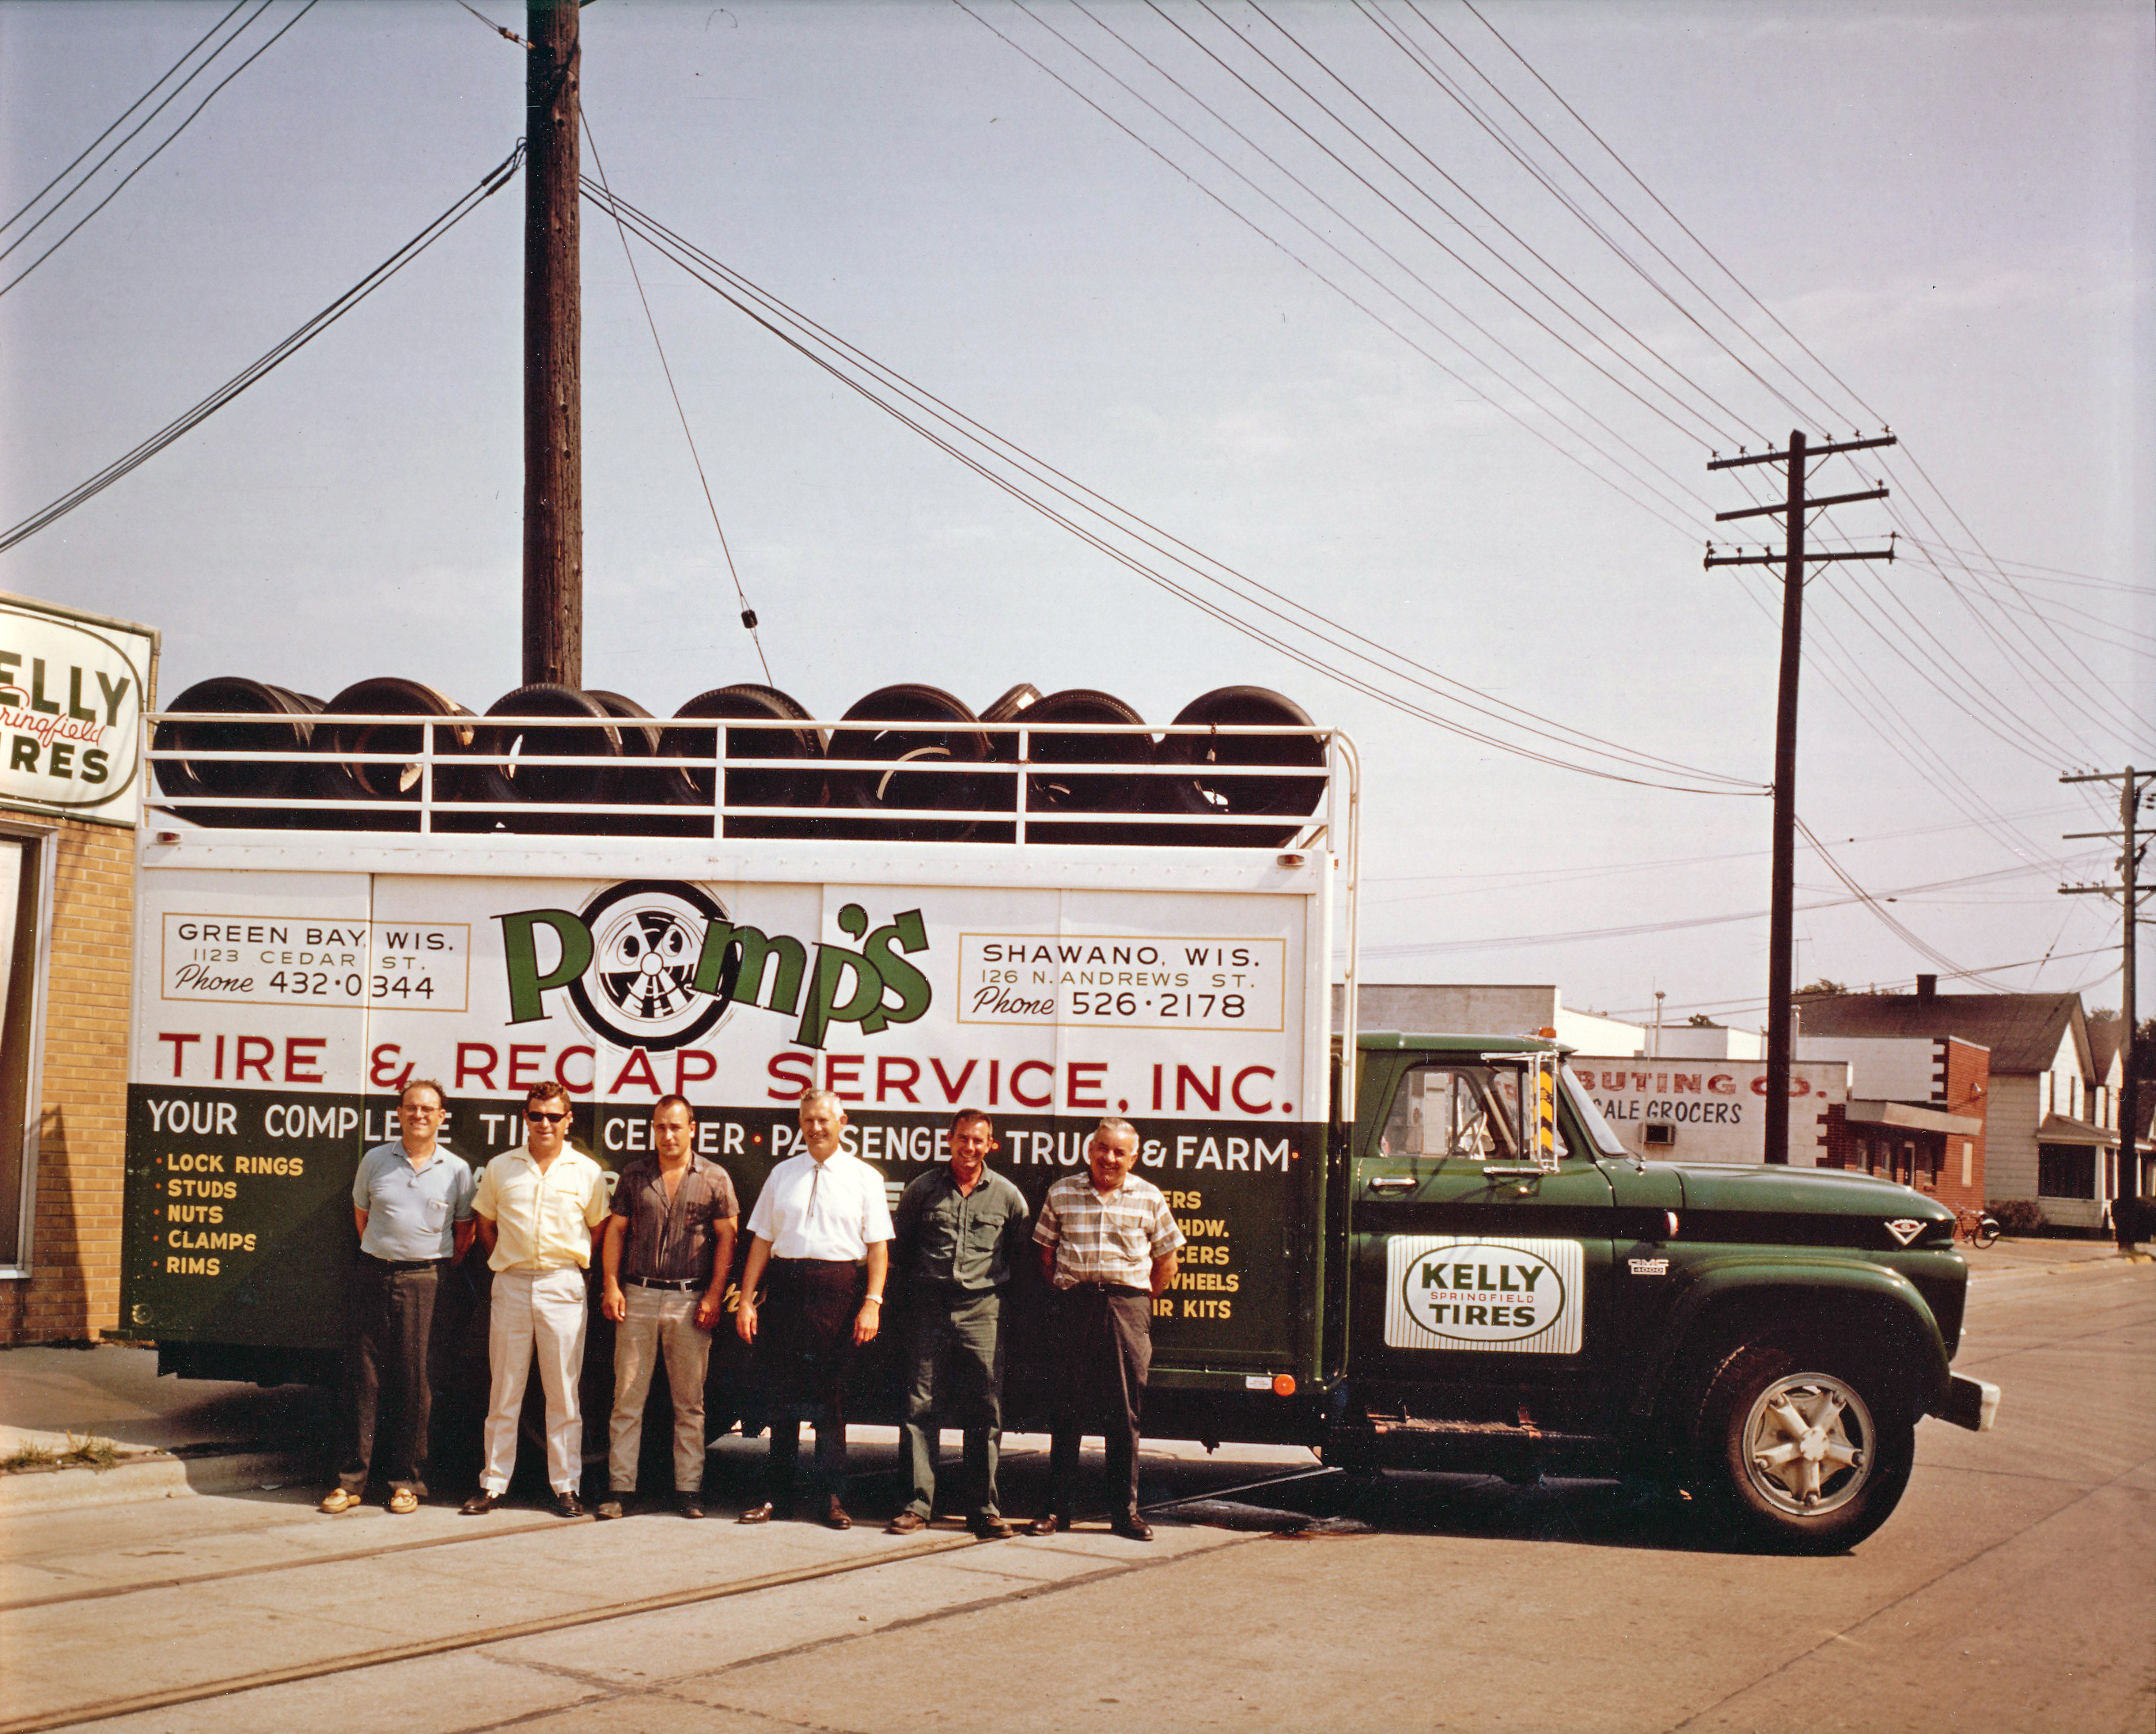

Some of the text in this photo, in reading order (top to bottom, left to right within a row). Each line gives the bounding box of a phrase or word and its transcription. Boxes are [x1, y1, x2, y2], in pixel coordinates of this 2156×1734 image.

[178, 923, 288, 944] GREEN
[386, 932, 453, 951] WIS.
[193, 948, 426, 970] 1123 CEDAR ST.
[983, 944, 1260, 967] SHAWANO, WIS.
[175, 964, 254, 993] Phone
[982, 969, 1255, 988] 126 N. ANDREWS ST.
[972, 985, 1055, 1016] Phone
[158, 1032, 1293, 1114] TIRE & RECAP SERVICE, INC.
[1647, 1100, 1742, 1124] GROCERS
[147, 1099, 237, 1135] YOUR
[265, 1104, 452, 1144] COMPLEE
[604, 1118, 745, 1154] CEER
[1142, 1139, 1167, 1168] &
[1176, 1135, 1289, 1172] FARM
[168, 1153, 304, 1176] LOCK RINGS
[168, 1179, 237, 1198] STUDS
[168, 1204, 223, 1224] NUTS
[1177, 1218, 1230, 1238] HDW.
[168, 1229, 257, 1251] CLAMPS
[166, 1256, 220, 1276] RIMS
[1422, 1263, 1544, 1293] KELLY
[1183, 1300, 1231, 1319] KITS
[1430, 1292, 1534, 1304] SPRINGFIELD
[1429, 1303, 1535, 1328] TIRES
